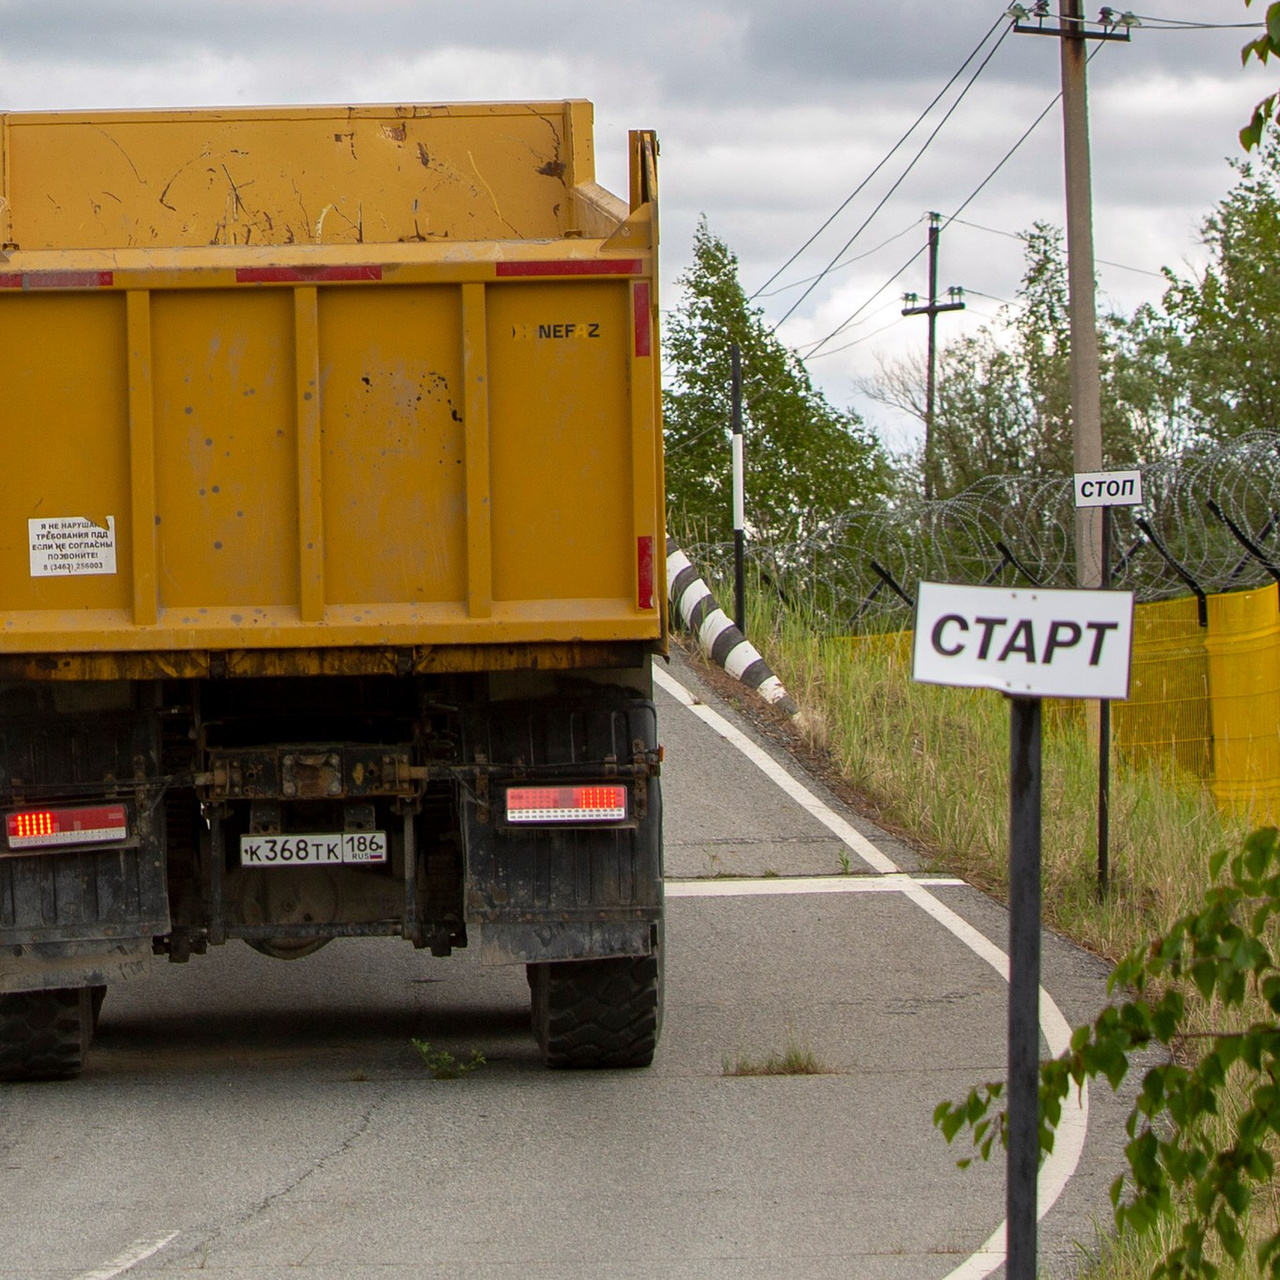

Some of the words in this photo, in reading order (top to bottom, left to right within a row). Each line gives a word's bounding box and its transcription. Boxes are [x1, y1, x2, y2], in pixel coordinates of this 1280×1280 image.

[1081, 479, 1135, 497] СТОП
[36, 532, 89, 540] ТРЕБОВАНИЯ
[91, 531, 108, 539] ПДД
[32, 543, 53, 551] ЕСЛИ
[55, 542, 66, 550] НЕ
[68, 540, 113, 549] СОГЛАСНЫ
[47, 552, 98, 560] ПОЗВОНИТЕ!
[930, 613, 1119, 666] СТАРТ
[249, 839, 339, 862] К368ТК
[345, 835, 379, 852] 186
